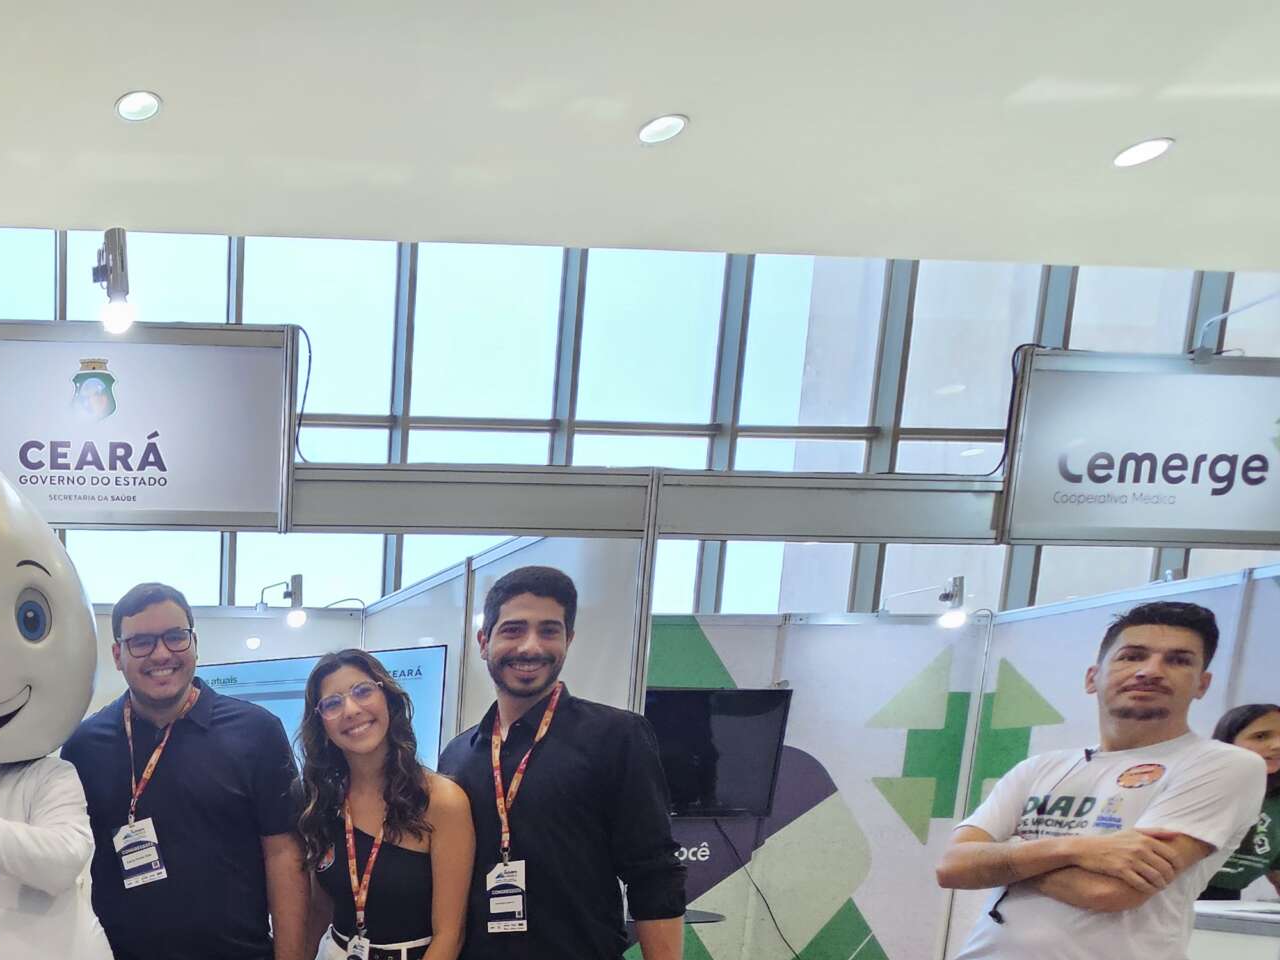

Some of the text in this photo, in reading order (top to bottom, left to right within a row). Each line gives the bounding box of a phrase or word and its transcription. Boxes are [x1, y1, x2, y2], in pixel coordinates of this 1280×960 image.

[19, 430, 168, 472] CEARÁ
[19, 475, 168, 487] GOVERNO DO ESTADO
[110, 494, 136, 502] SAÚDE
[389, 665, 423, 678] EARÁ
[674, 842, 711, 861] ocê
